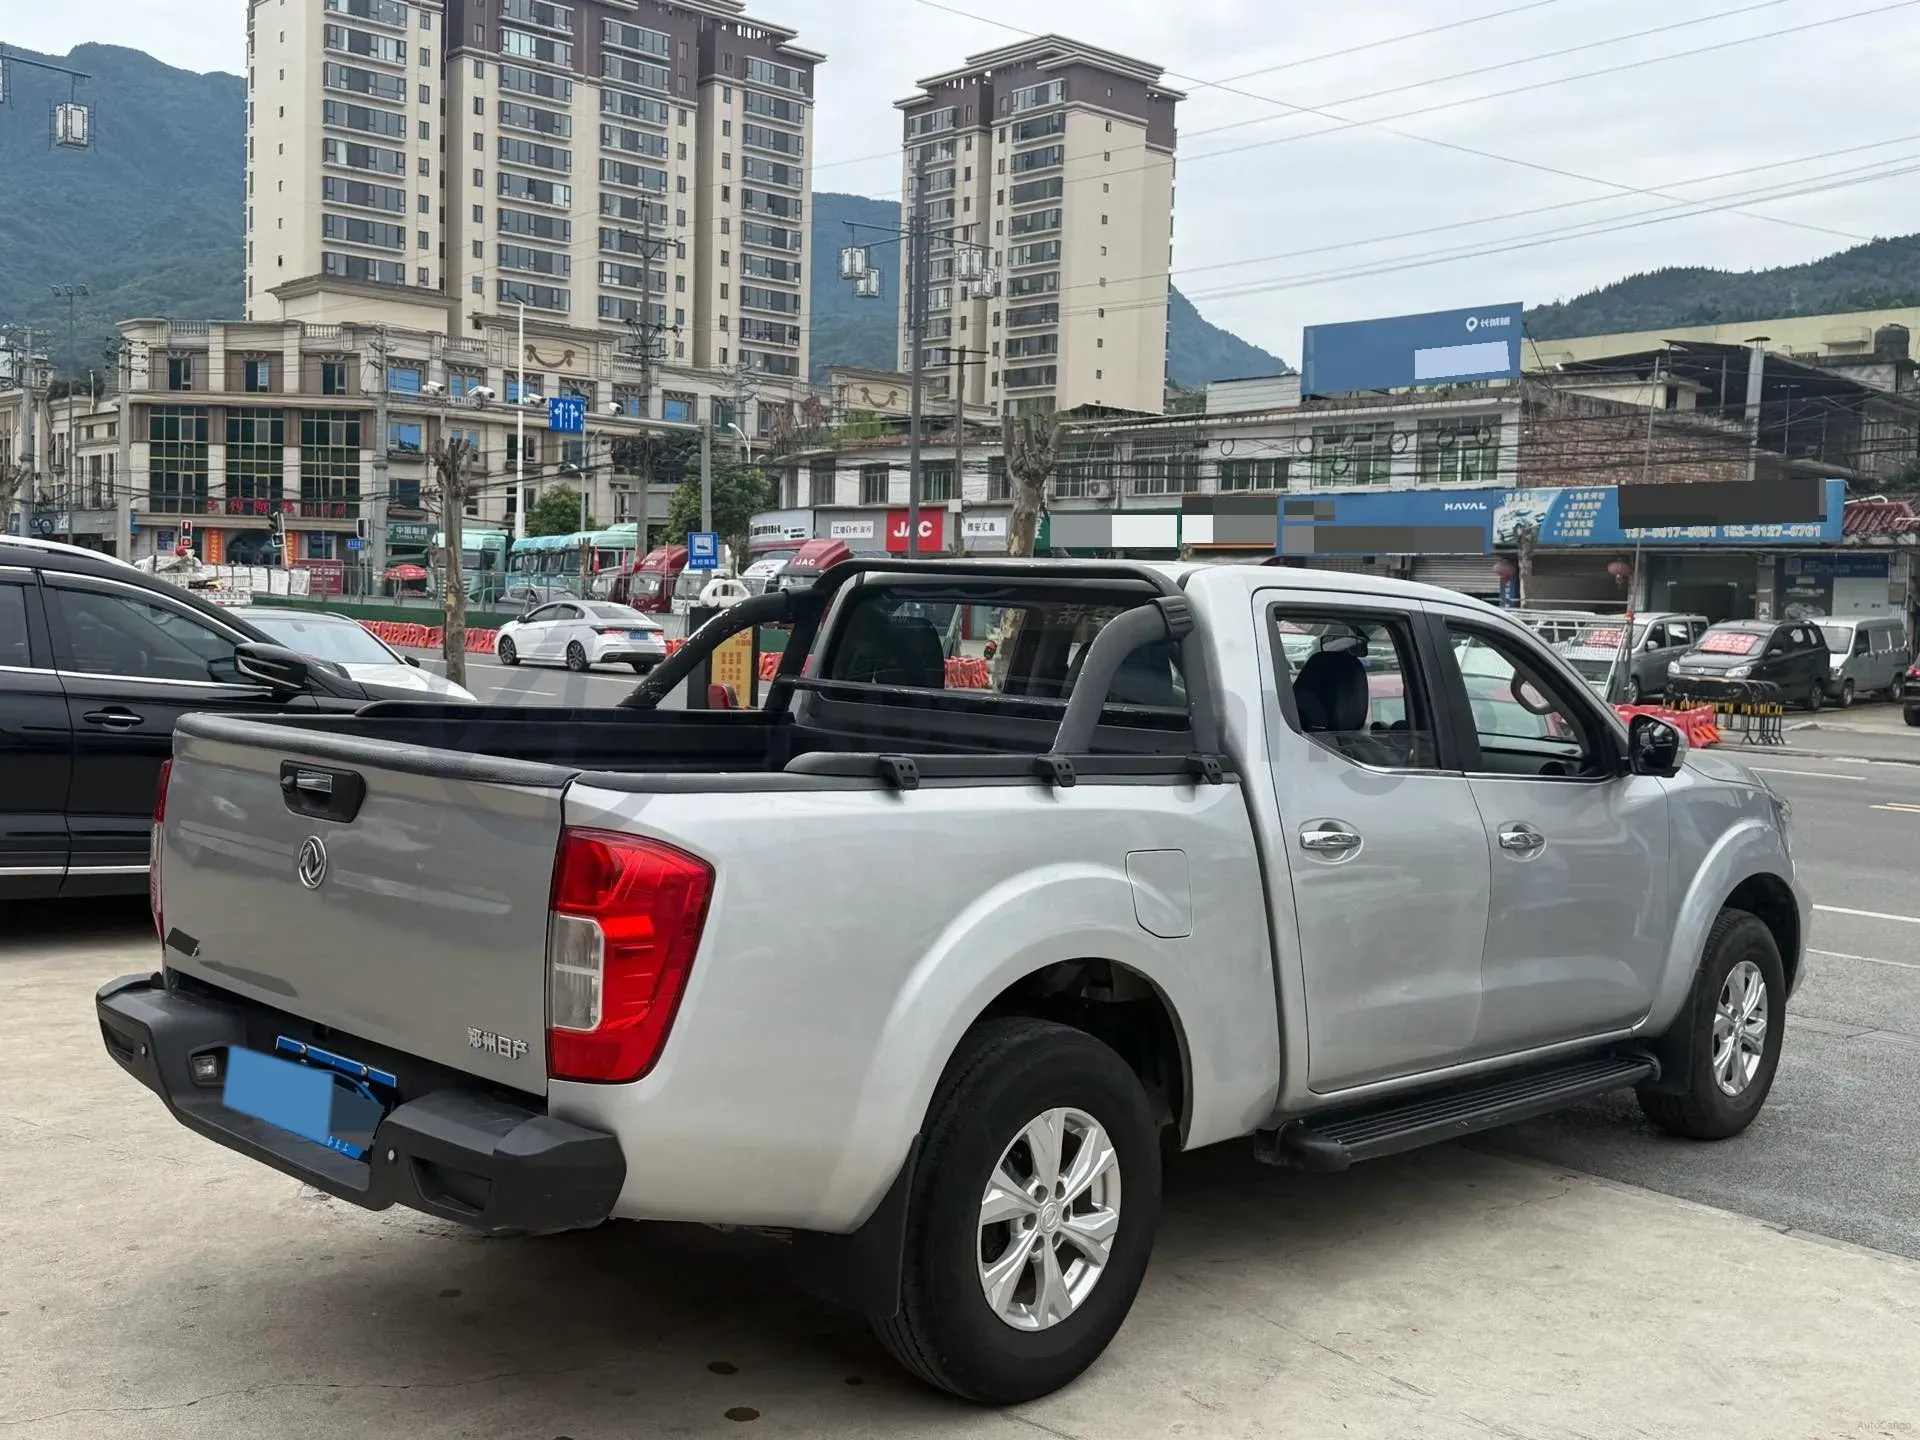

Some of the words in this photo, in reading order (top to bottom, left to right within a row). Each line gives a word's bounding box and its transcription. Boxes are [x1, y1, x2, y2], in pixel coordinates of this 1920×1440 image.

[1444, 502, 1487, 511] HAVAL
[796, 558, 816, 566] JAC
[467, 1026, 528, 1060] 郑州日产
